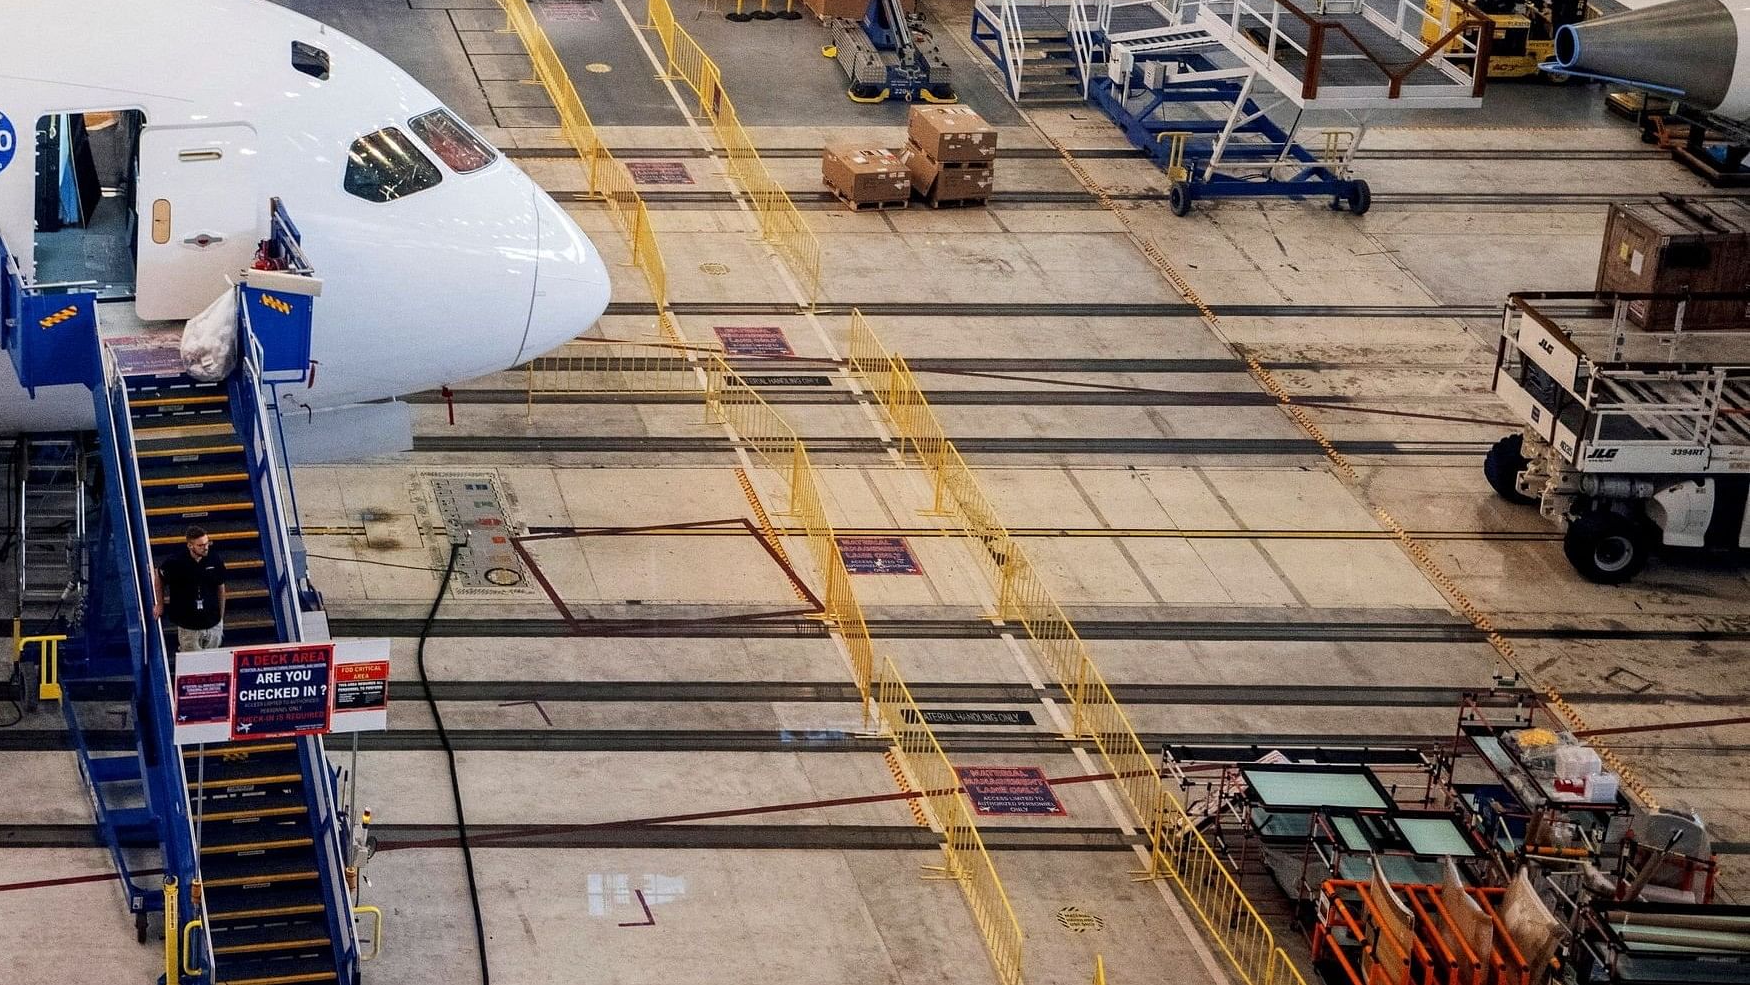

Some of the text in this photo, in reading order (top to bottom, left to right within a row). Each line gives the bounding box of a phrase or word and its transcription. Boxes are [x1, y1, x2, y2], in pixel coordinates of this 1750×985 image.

[1537, 338, 1555, 356] JLG
[1586, 448, 1620, 459] JLG
[1670, 448, 1705, 457] 3394RT
[241, 651, 326, 667] A DECK AREA
[255, 669, 312, 685] ARE YOU
[239, 686, 300, 702] CHECKED
[303, 685, 317, 697] IN
[320, 684, 328, 696] ?
[916, 711, 1020, 722] ATERIAL HANDLING ONLY
[969, 769, 1029, 778] MATERIAL
[976, 786, 1042, 794] LANE ONLY
